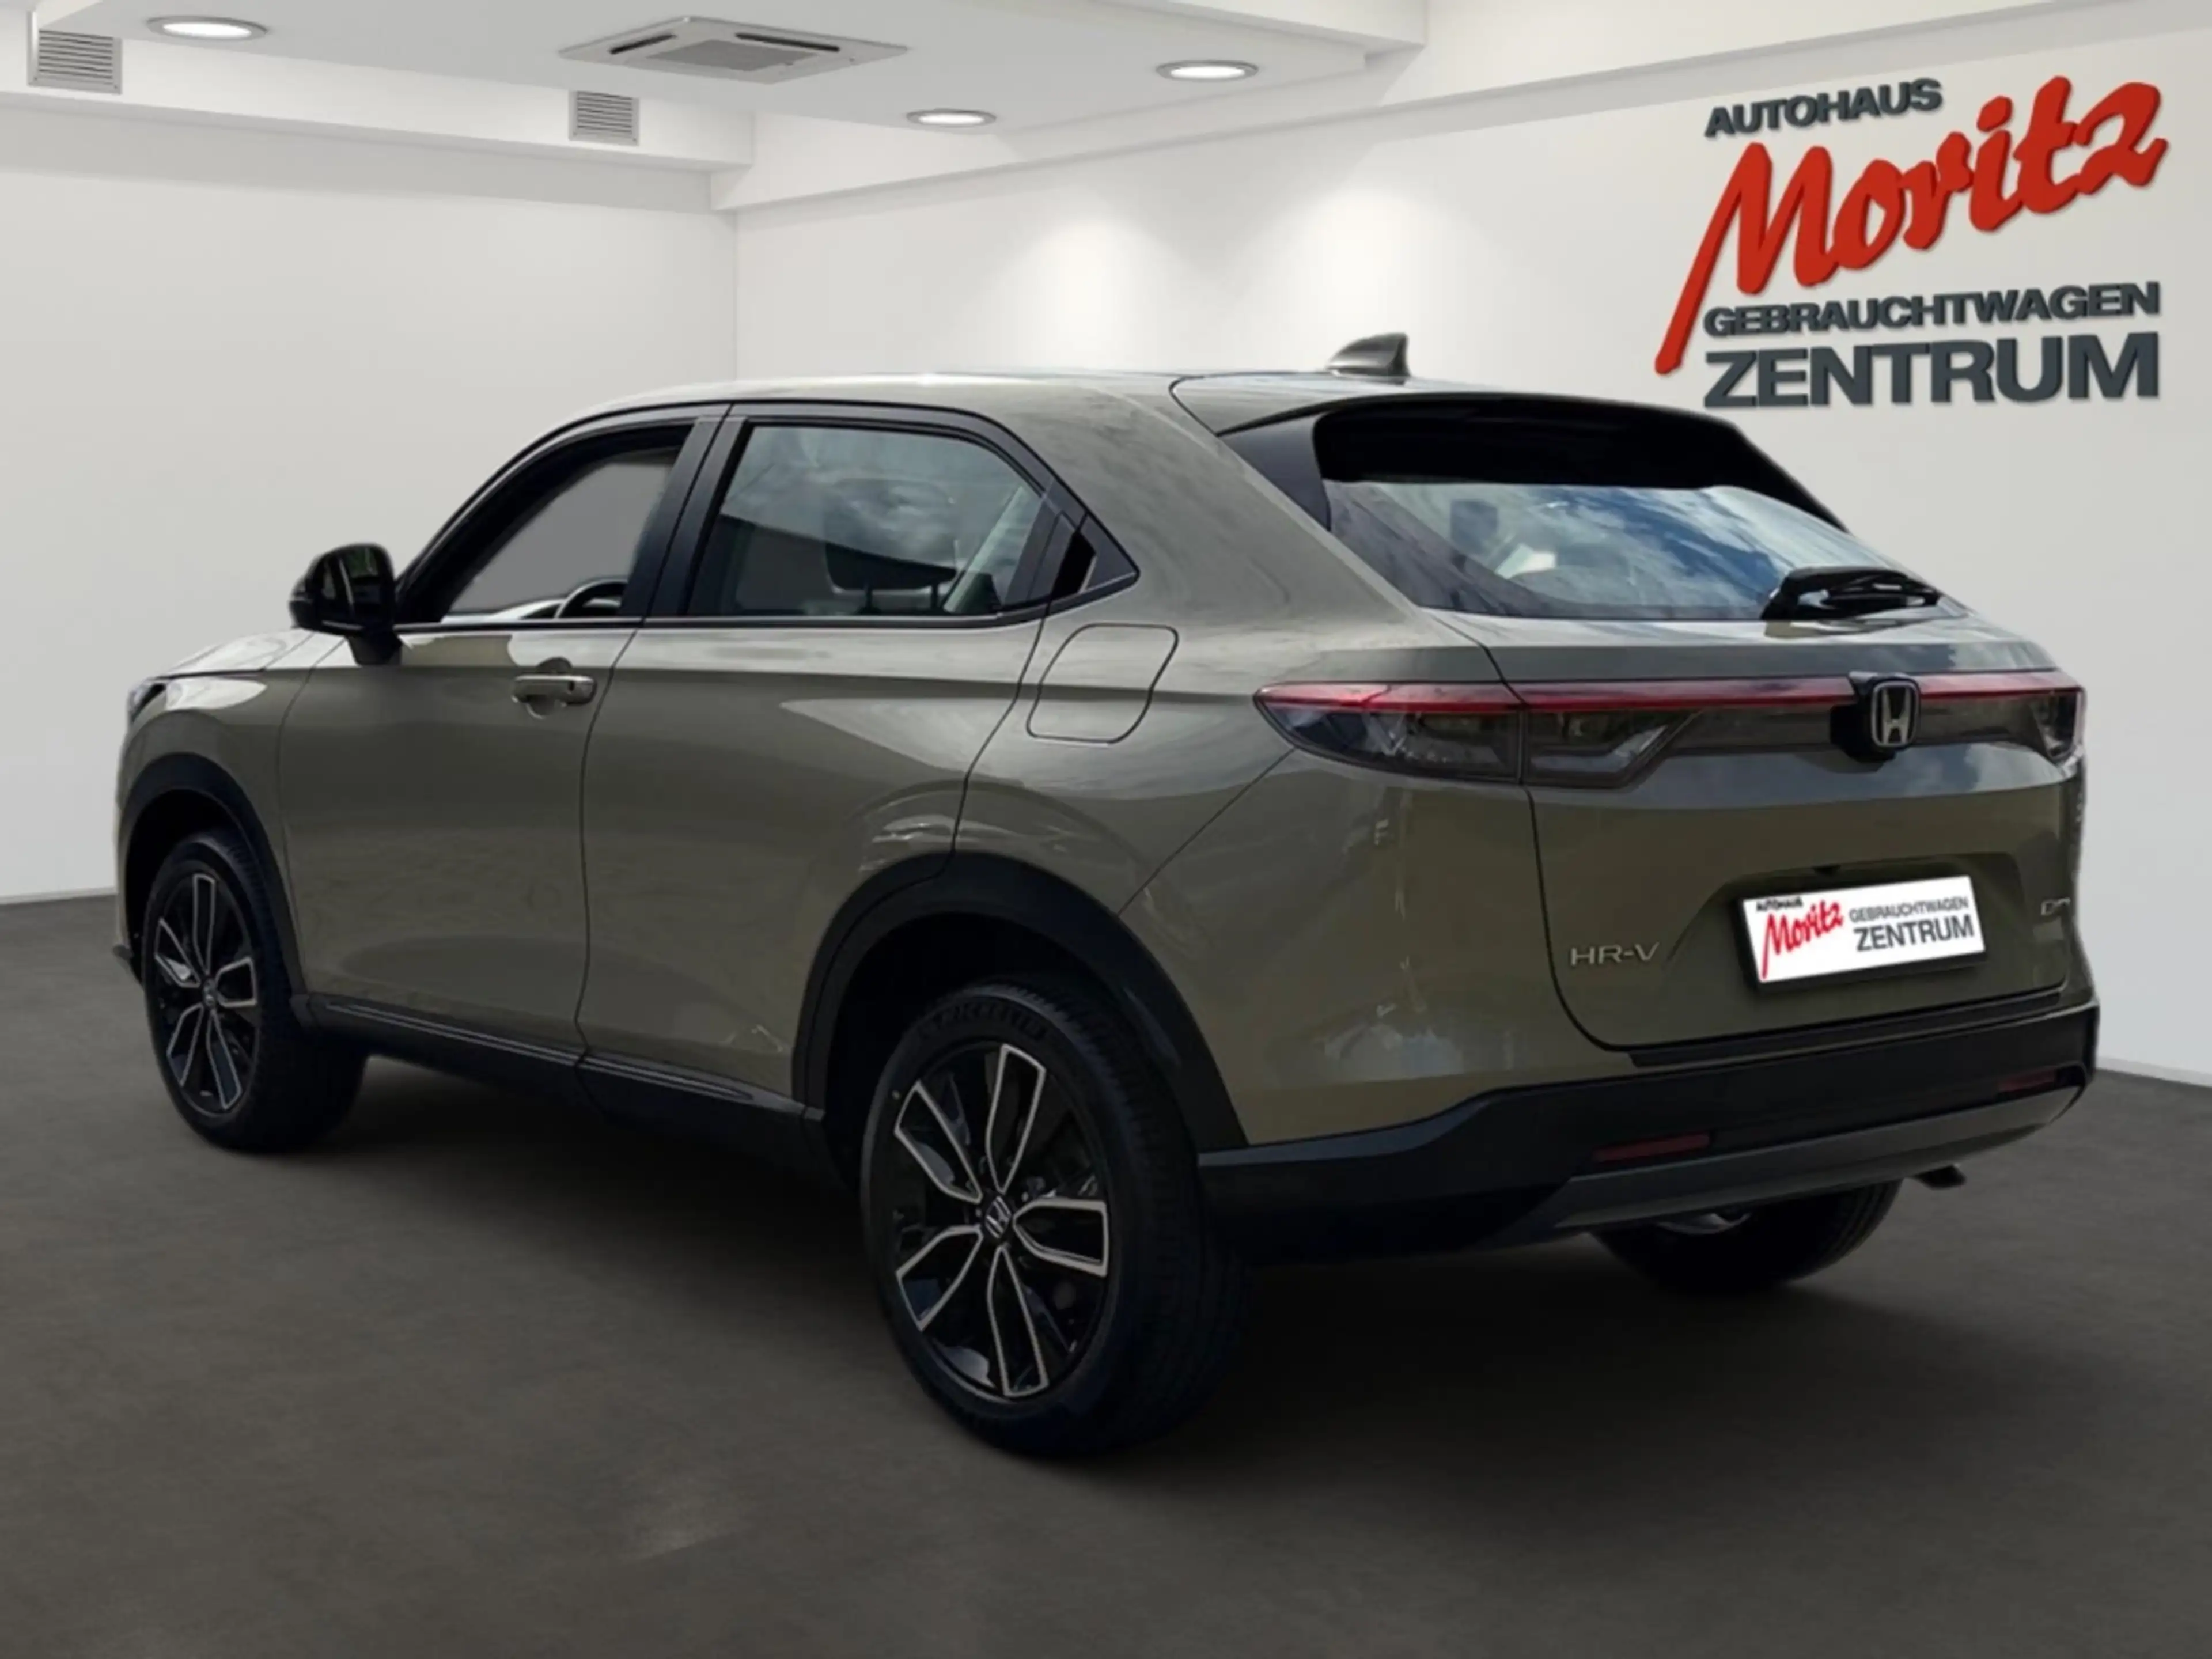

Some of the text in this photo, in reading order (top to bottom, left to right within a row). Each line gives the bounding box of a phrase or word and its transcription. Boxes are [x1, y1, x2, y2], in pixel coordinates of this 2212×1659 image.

[1705, 78, 1944, 138] AUTOHAUS
[1654, 75, 2168, 376] Moritz
[1703, 282, 2160, 337] GEBRAUCHTWAGEN
[1703, 332, 2160, 408] ZENTRUM
[1849, 896, 1968, 922] GEBRAUCHTWAGEN
[1854, 915, 1974, 952] ZENTRUM
[1571, 942, 1660, 965] HR-V
[1762, 900, 1843, 979] Moritz
